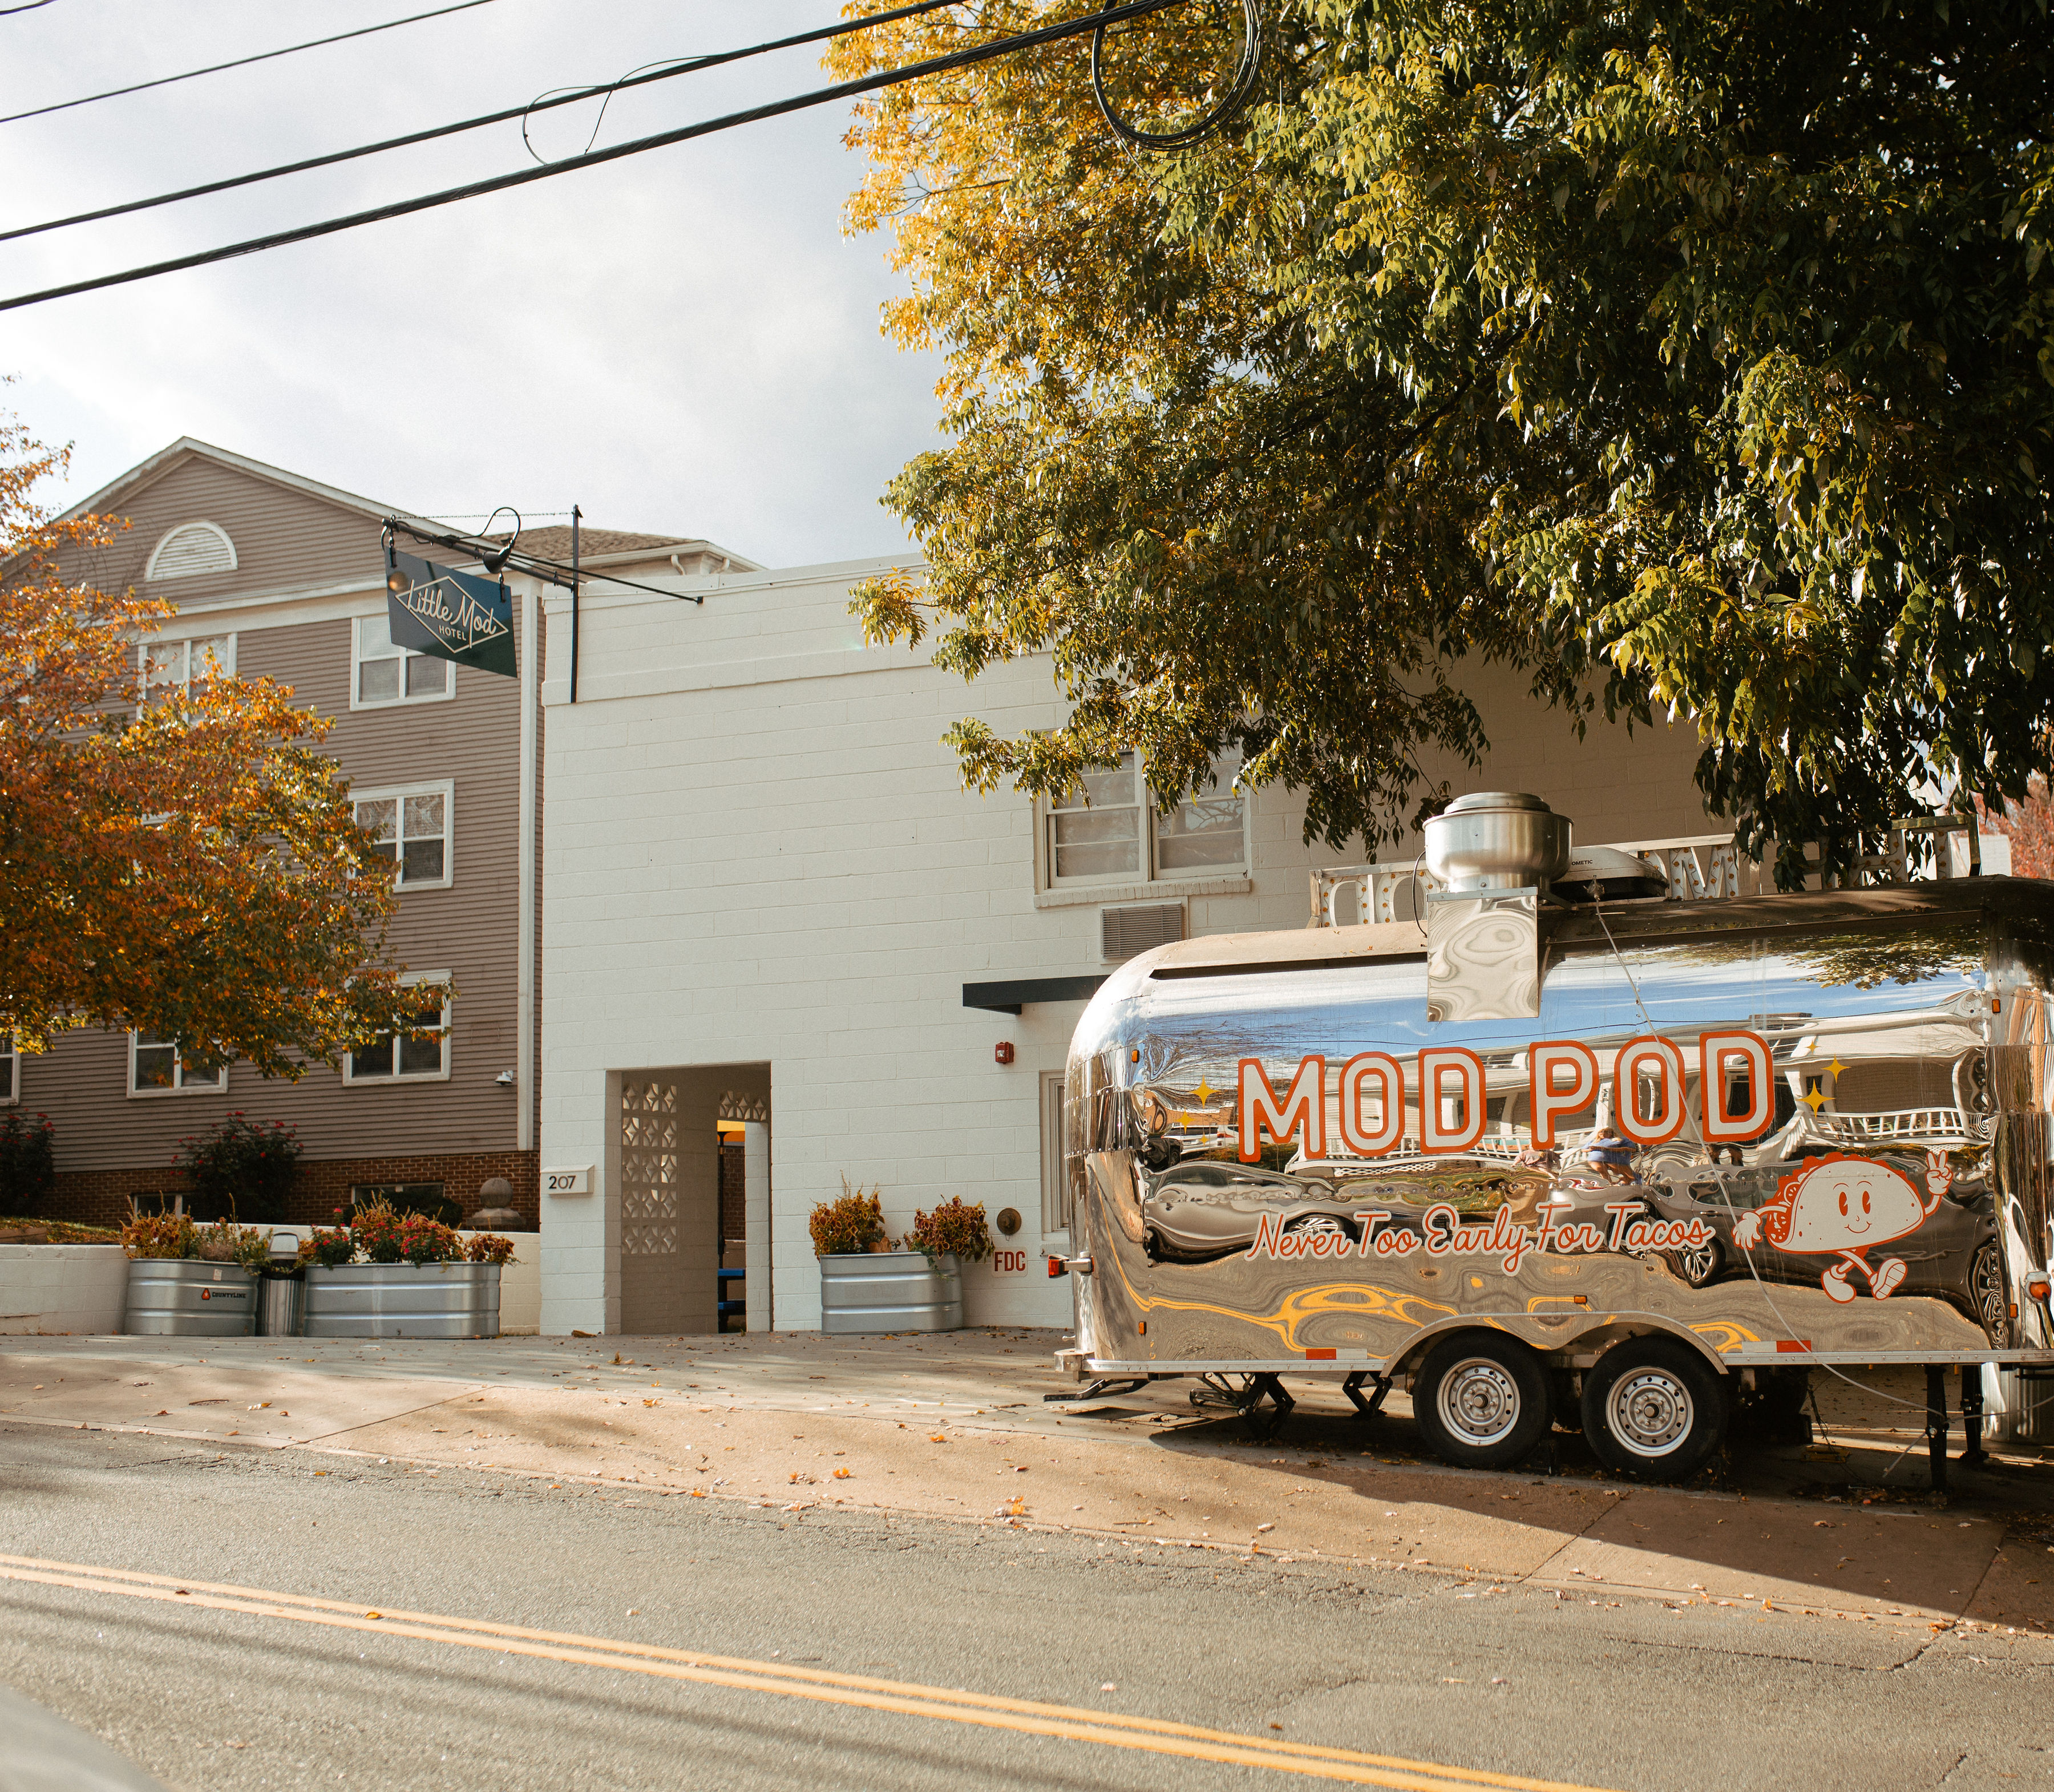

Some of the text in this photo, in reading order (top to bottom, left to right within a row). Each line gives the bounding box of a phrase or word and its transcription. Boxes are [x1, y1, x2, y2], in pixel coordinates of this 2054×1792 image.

[407, 579, 497, 649] Little Mod
[438, 625, 467, 641] HOTEL
[1238, 1030, 1774, 1163] MOD POD
[548, 1175, 576, 1189] 207
[994, 1251, 1025, 1271] FDC
[1245, 1201, 1716, 1276] Never Too Early For Tacos
